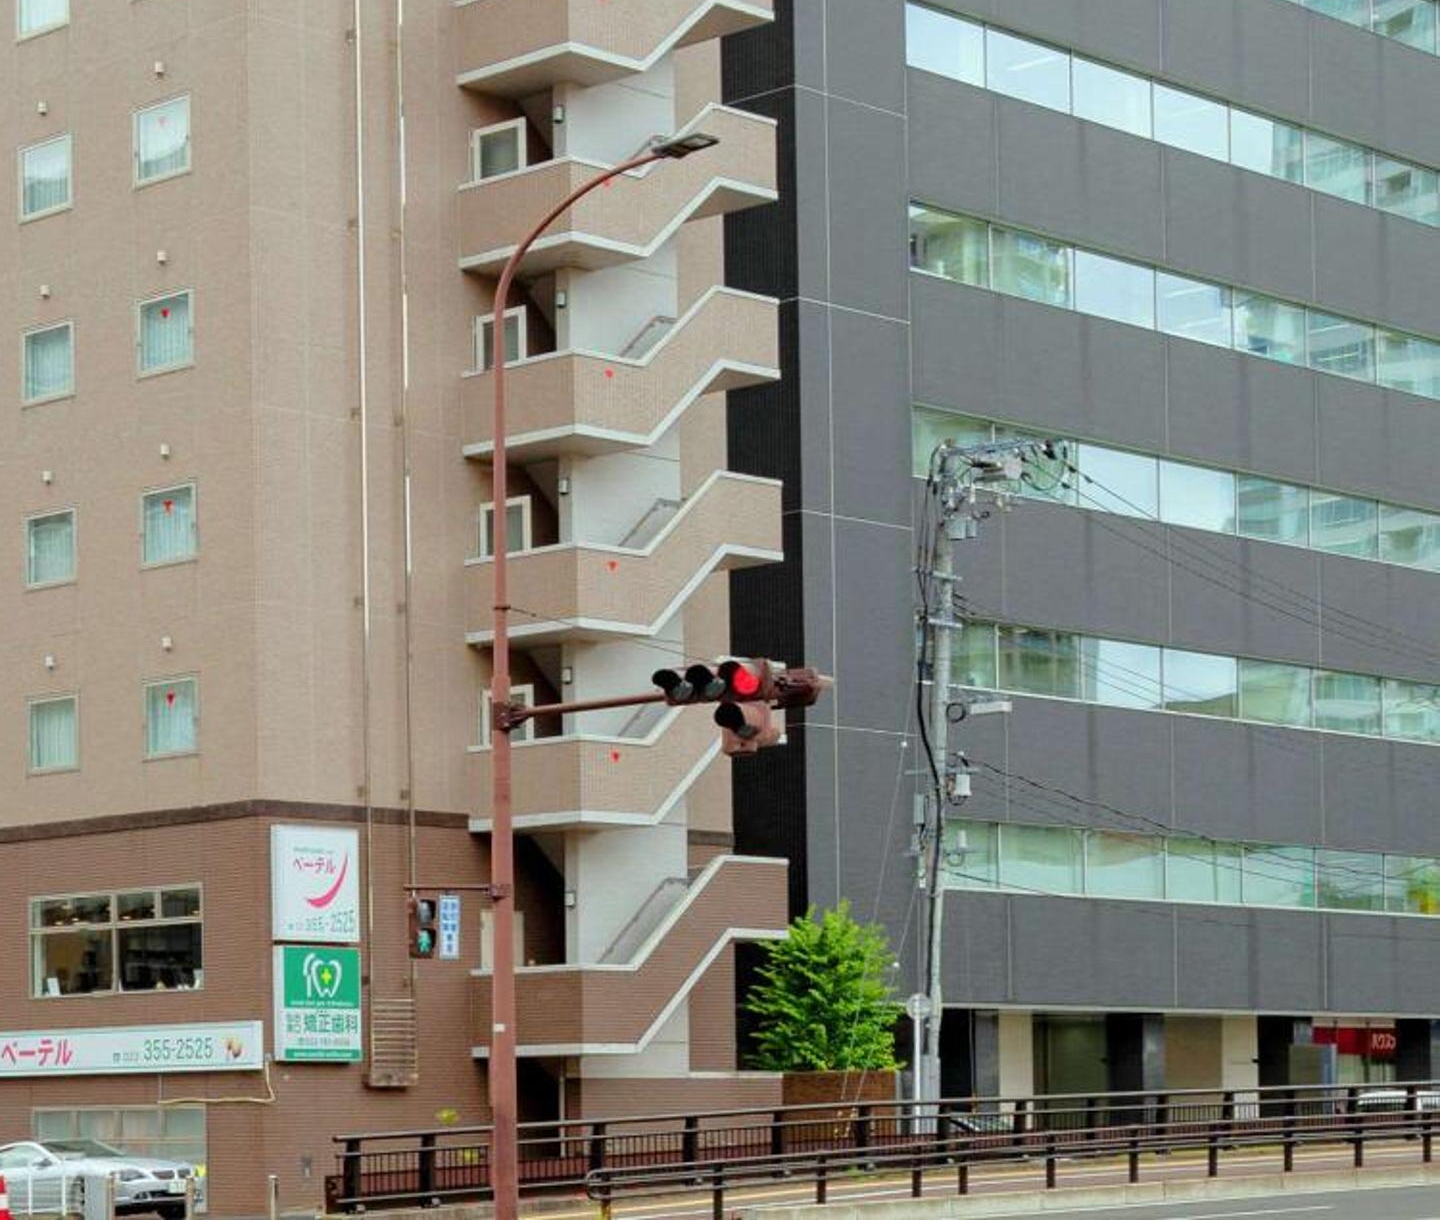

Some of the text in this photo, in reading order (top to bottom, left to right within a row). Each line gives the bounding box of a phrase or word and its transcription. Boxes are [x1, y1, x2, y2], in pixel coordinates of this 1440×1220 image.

[303, 1012, 358, 1035] 矯正歯科
[143, 1037, 214, 1062] 355-2525
